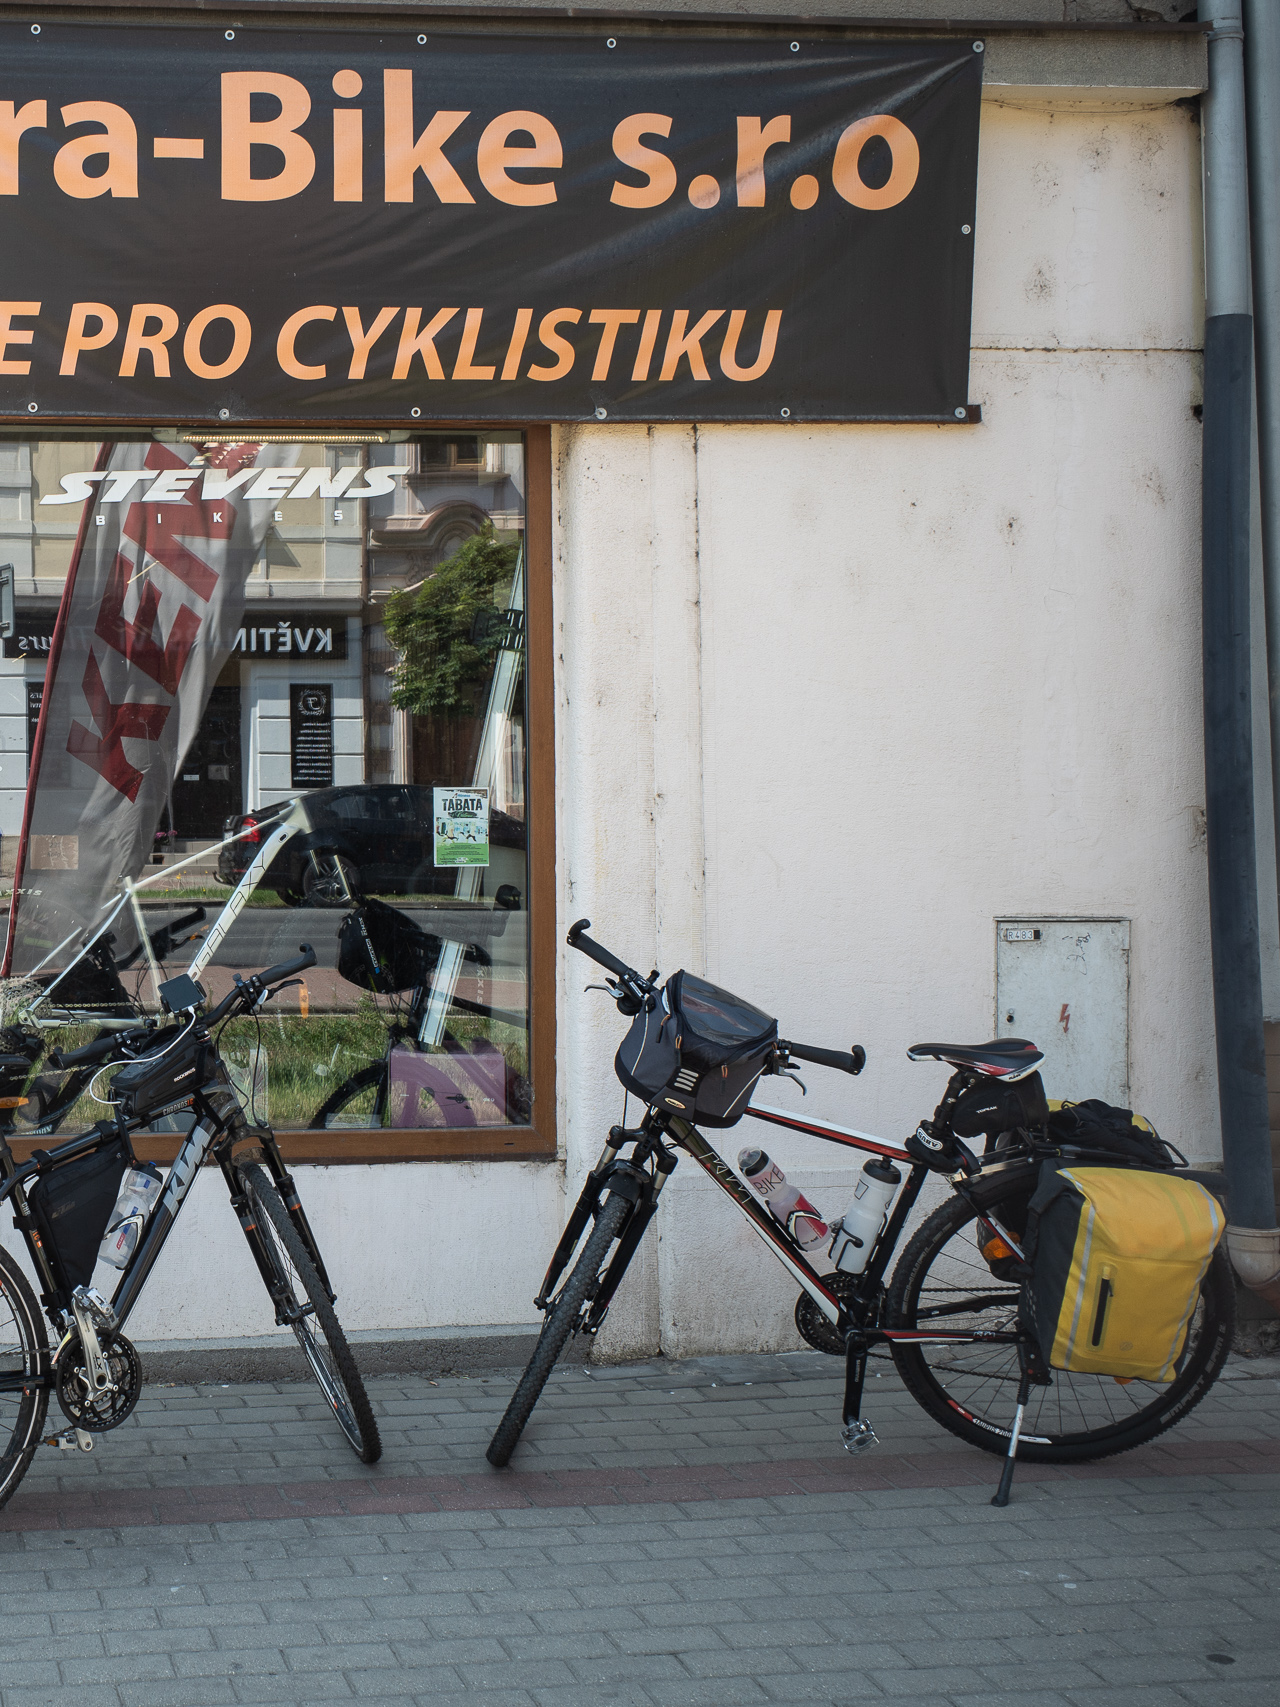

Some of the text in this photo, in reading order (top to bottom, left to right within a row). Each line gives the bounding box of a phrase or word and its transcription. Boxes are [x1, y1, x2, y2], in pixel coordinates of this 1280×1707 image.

[609, 112, 920, 211] s.r.o
[58, 301, 252, 380] PRO
[275, 304, 783, 382] CYKLISTIKU
[39, 466, 411, 505] STEVENS
[441, 798, 483, 811] TABATA
[753, 1165, 786, 1195] BIKE
